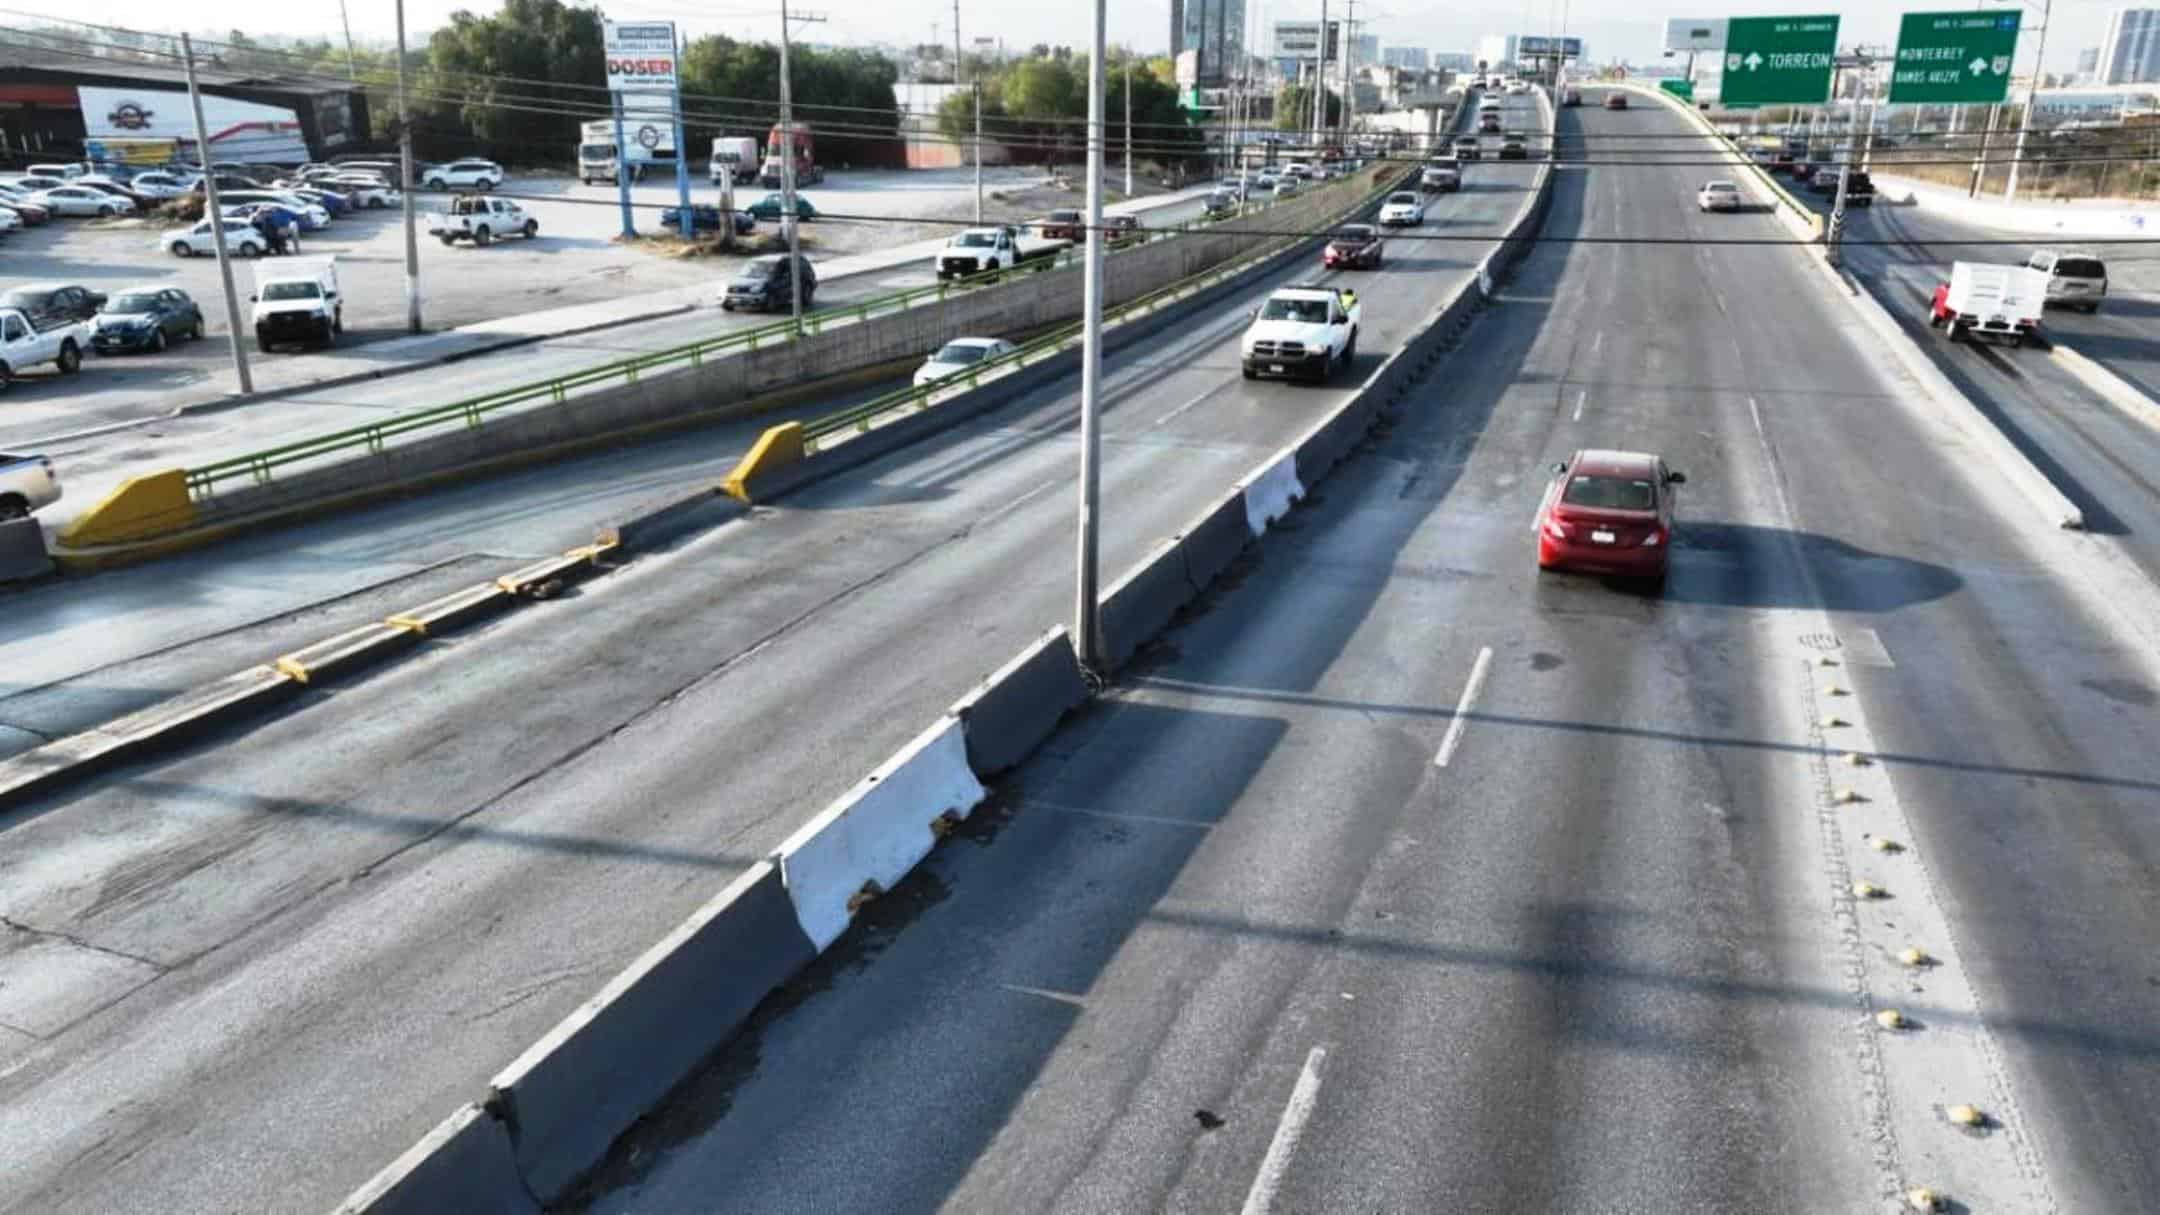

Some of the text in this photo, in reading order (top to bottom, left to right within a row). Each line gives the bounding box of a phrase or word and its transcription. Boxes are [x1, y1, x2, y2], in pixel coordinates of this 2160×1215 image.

[1899, 47, 1966, 60] MONTERREY
[608, 60, 672, 75] DOSER
[1768, 53, 1831, 70] TORREON
